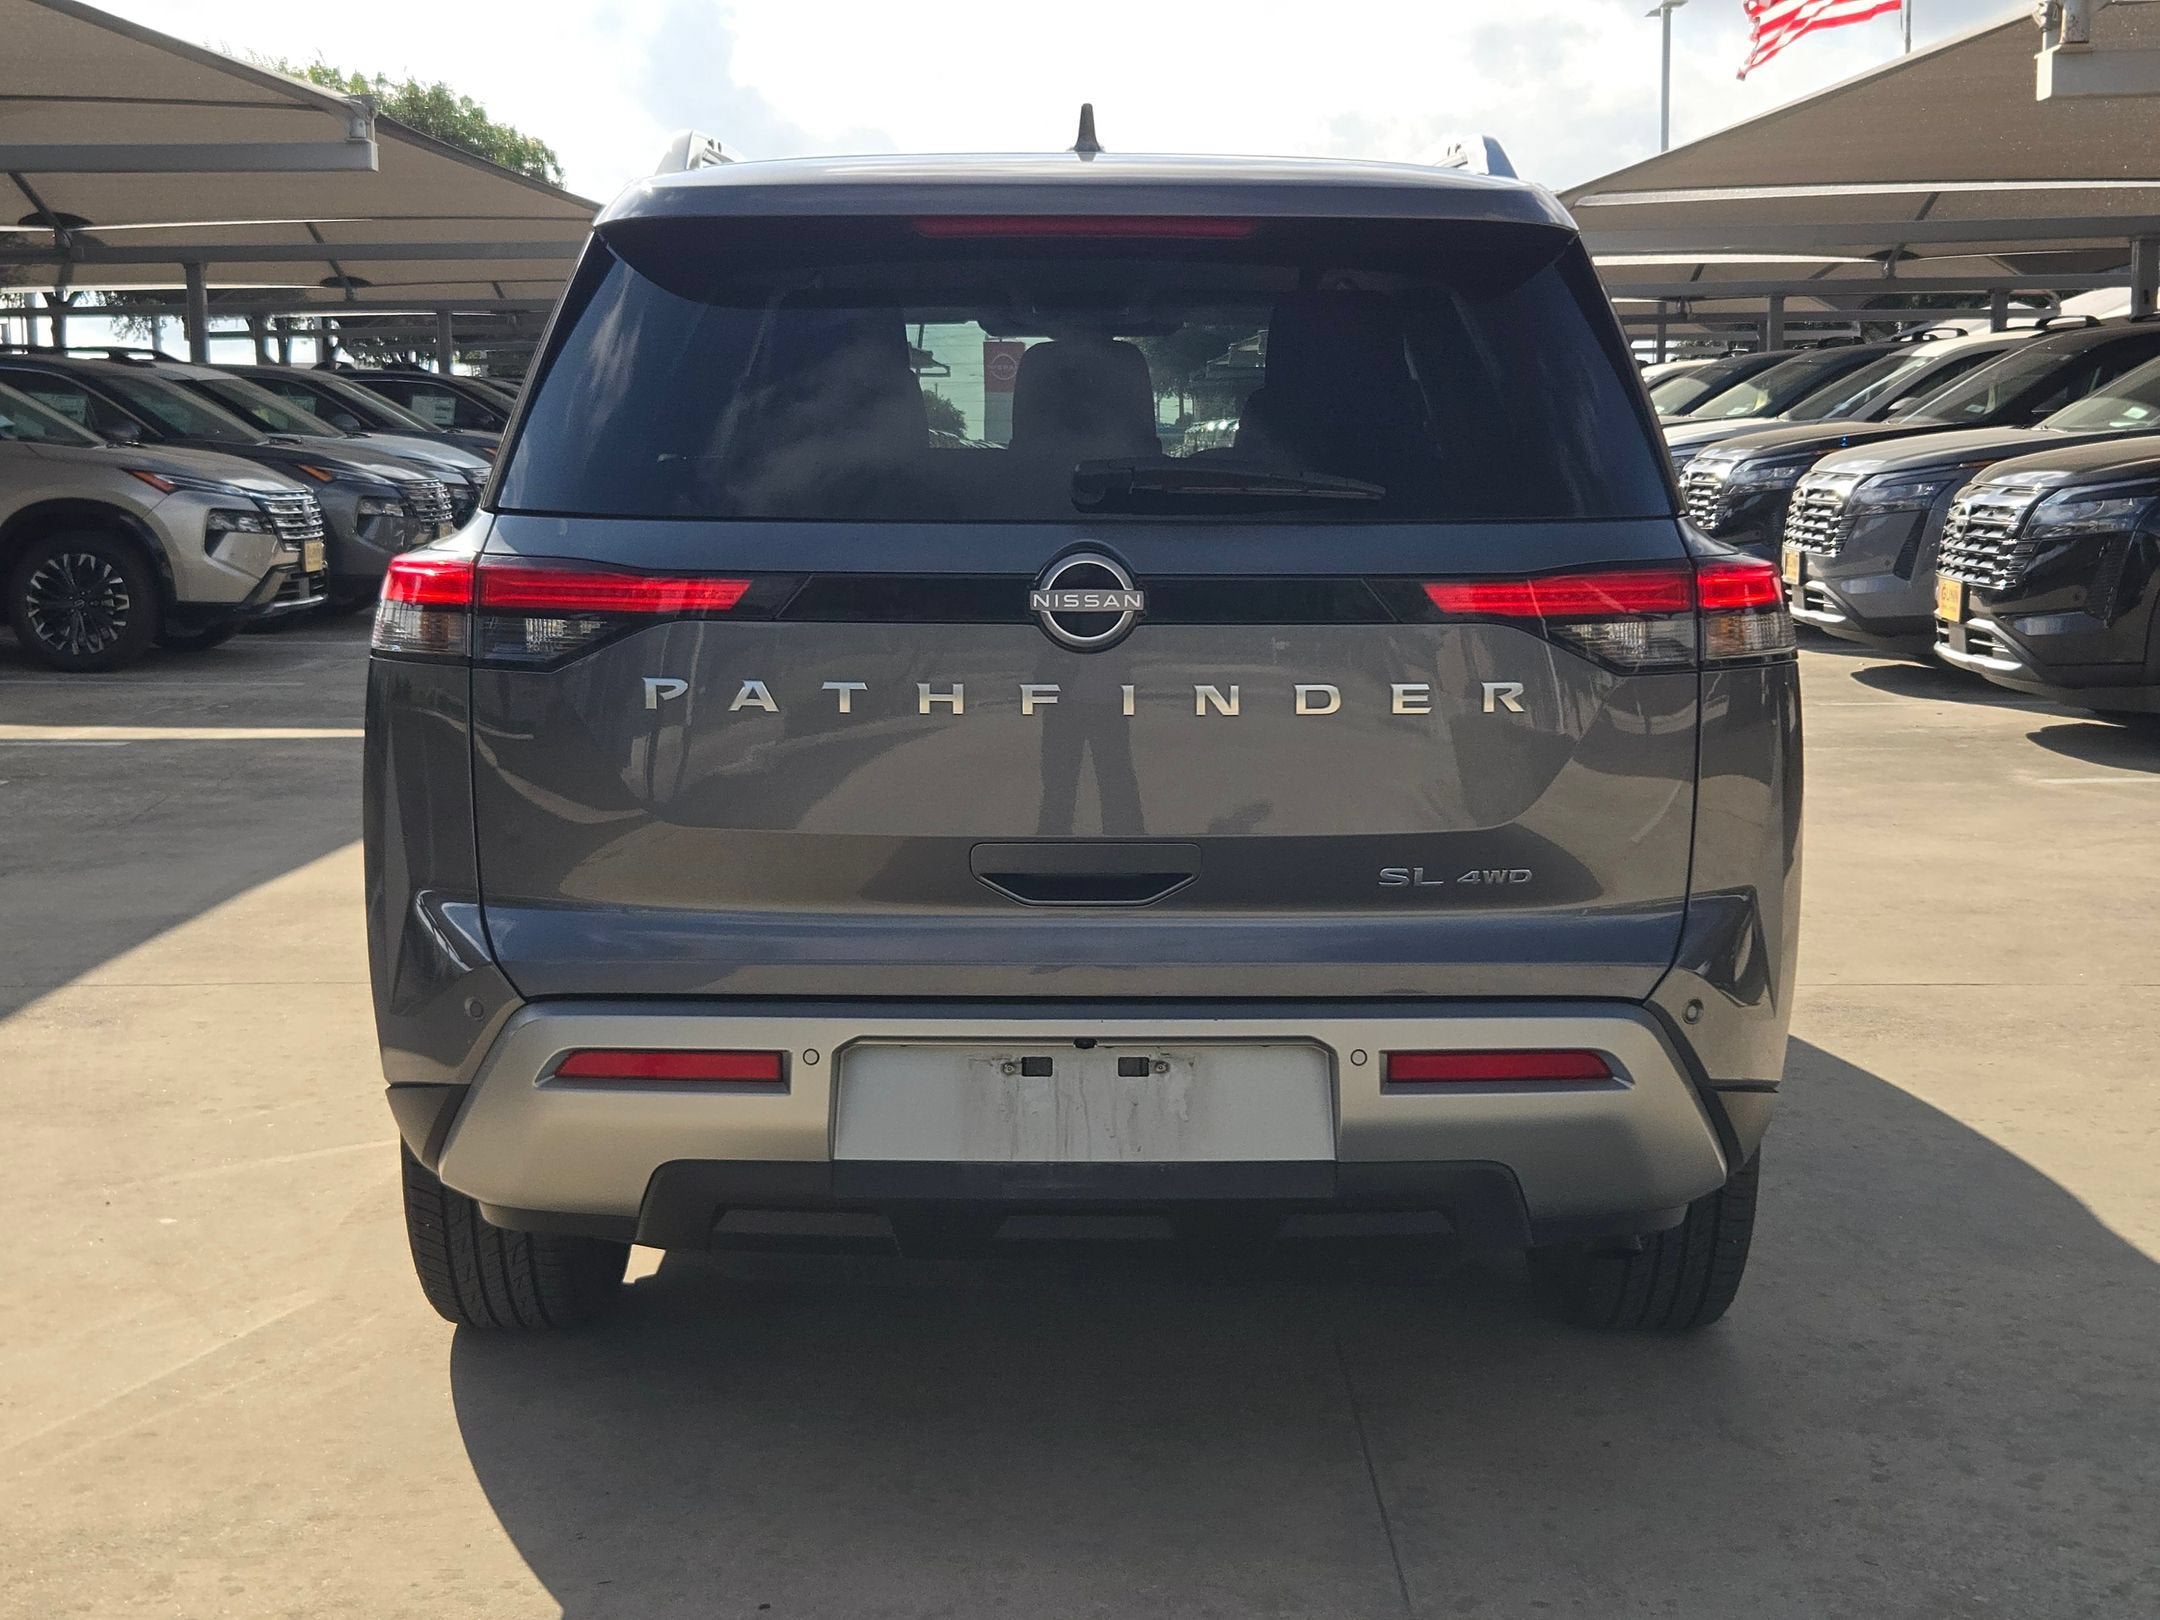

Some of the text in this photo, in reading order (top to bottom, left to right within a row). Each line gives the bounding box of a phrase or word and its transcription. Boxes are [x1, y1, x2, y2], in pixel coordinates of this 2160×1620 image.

[1033, 594, 1141, 608] NISSAN
[641, 676, 1526, 716] PATHFINDER
[1378, 867, 1533, 886] SL 4WD
